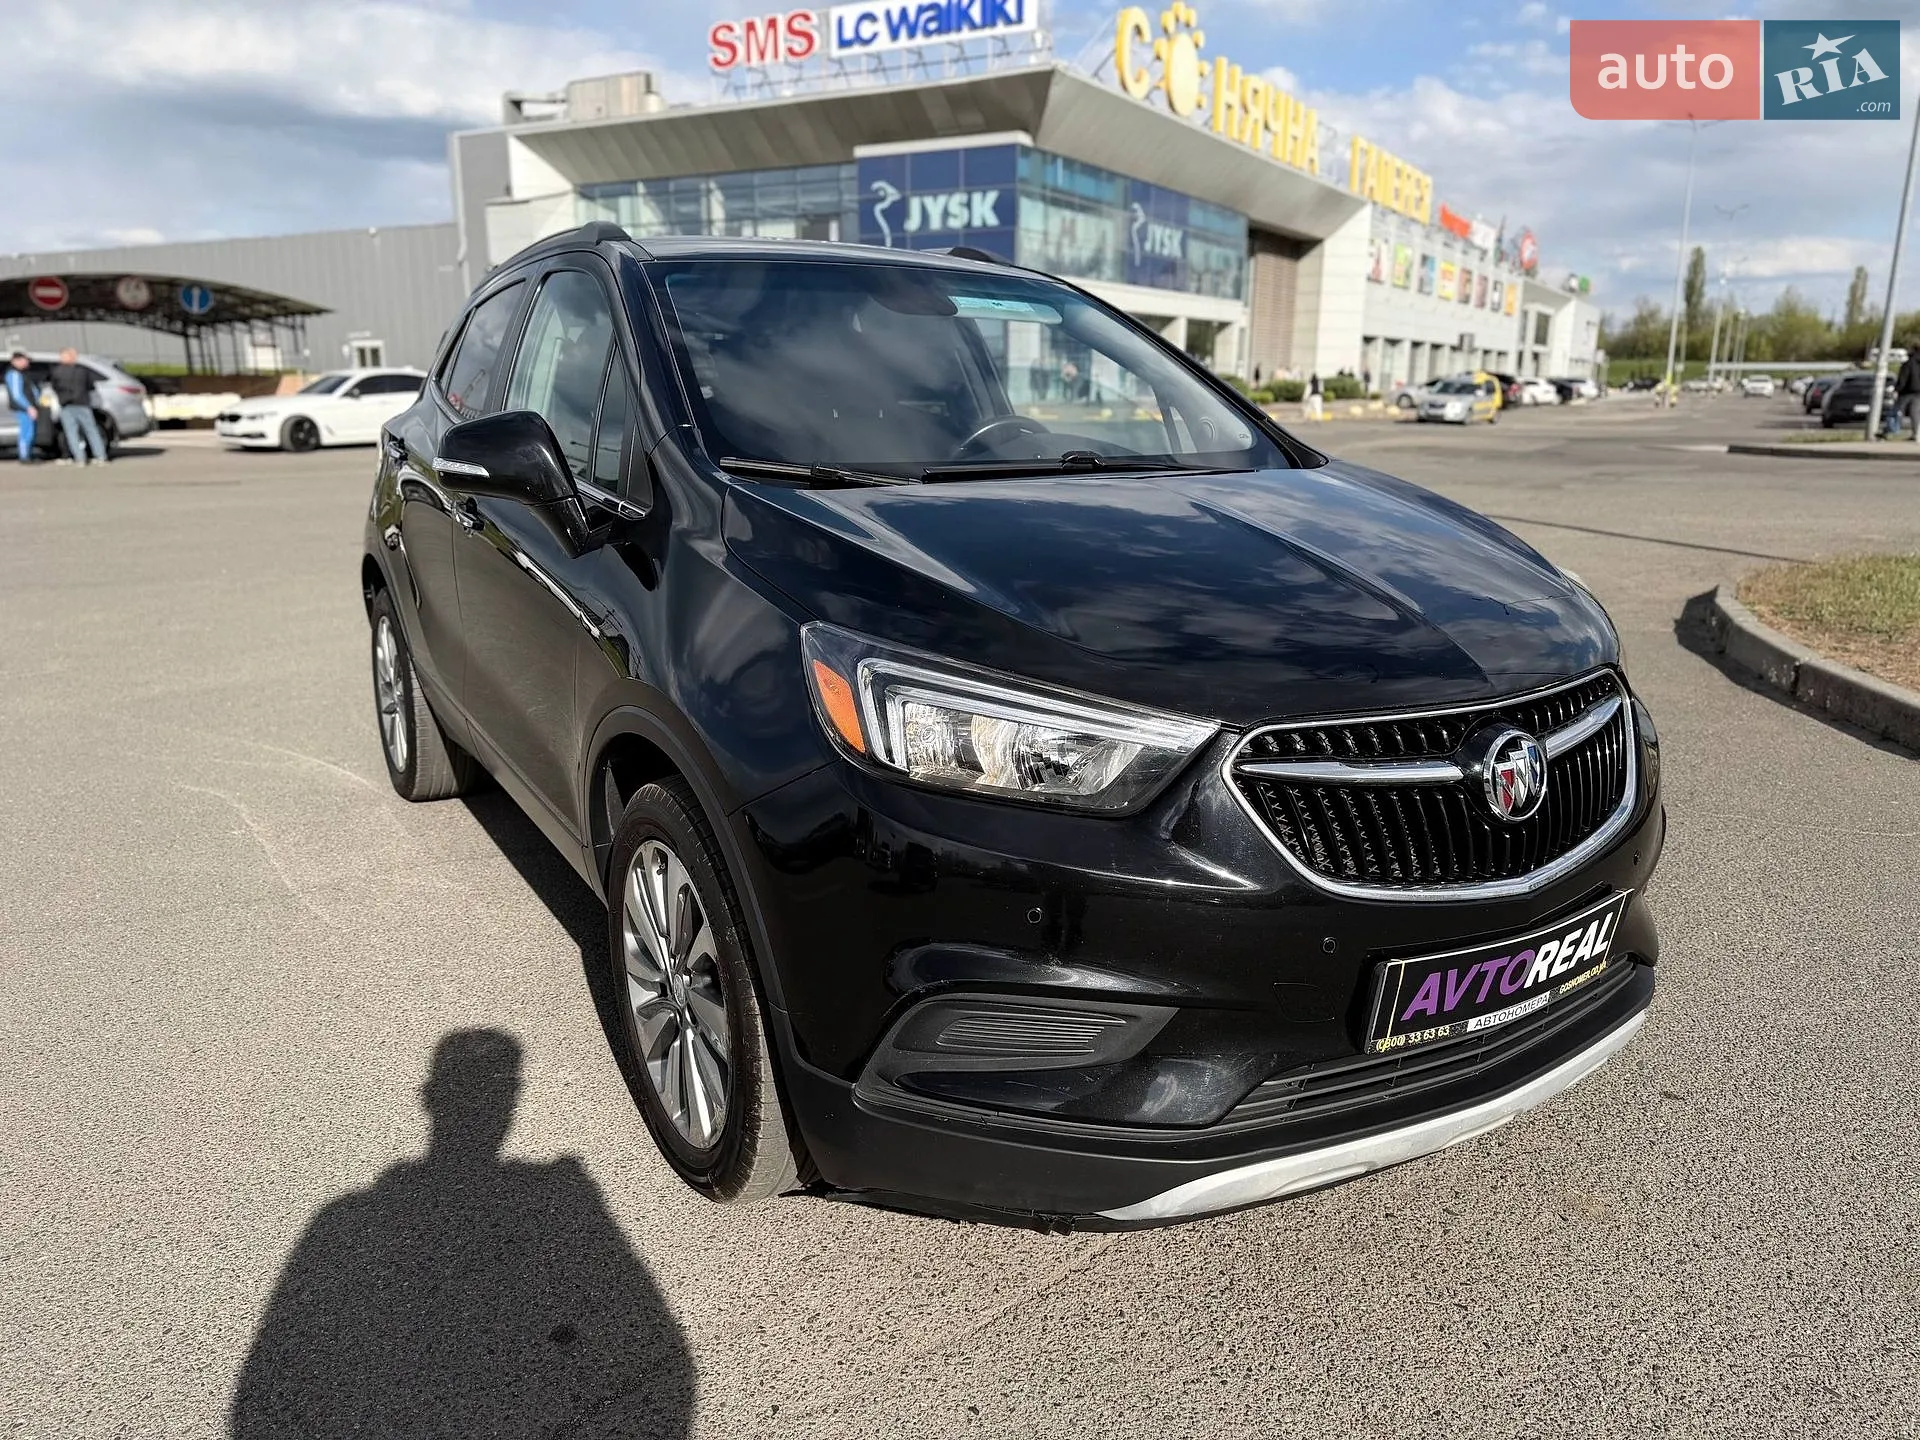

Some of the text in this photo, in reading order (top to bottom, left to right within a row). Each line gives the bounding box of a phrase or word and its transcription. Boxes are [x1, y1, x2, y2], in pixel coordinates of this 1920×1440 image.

[709, 11, 816, 69] SMS
[836, 11, 880, 50] LC
[903, 190, 1000, 232] JYSK
[1144, 223, 1184, 258] JYSK
[1400, 911, 1614, 1022] AVTOREAL
[1473, 994, 1549, 1029] АВТОНОМЕРА
[1408, 1032, 1421, 1044] 33
[1423, 1028, 1436, 1040] 63
[1438, 1025, 1450, 1037] 63
